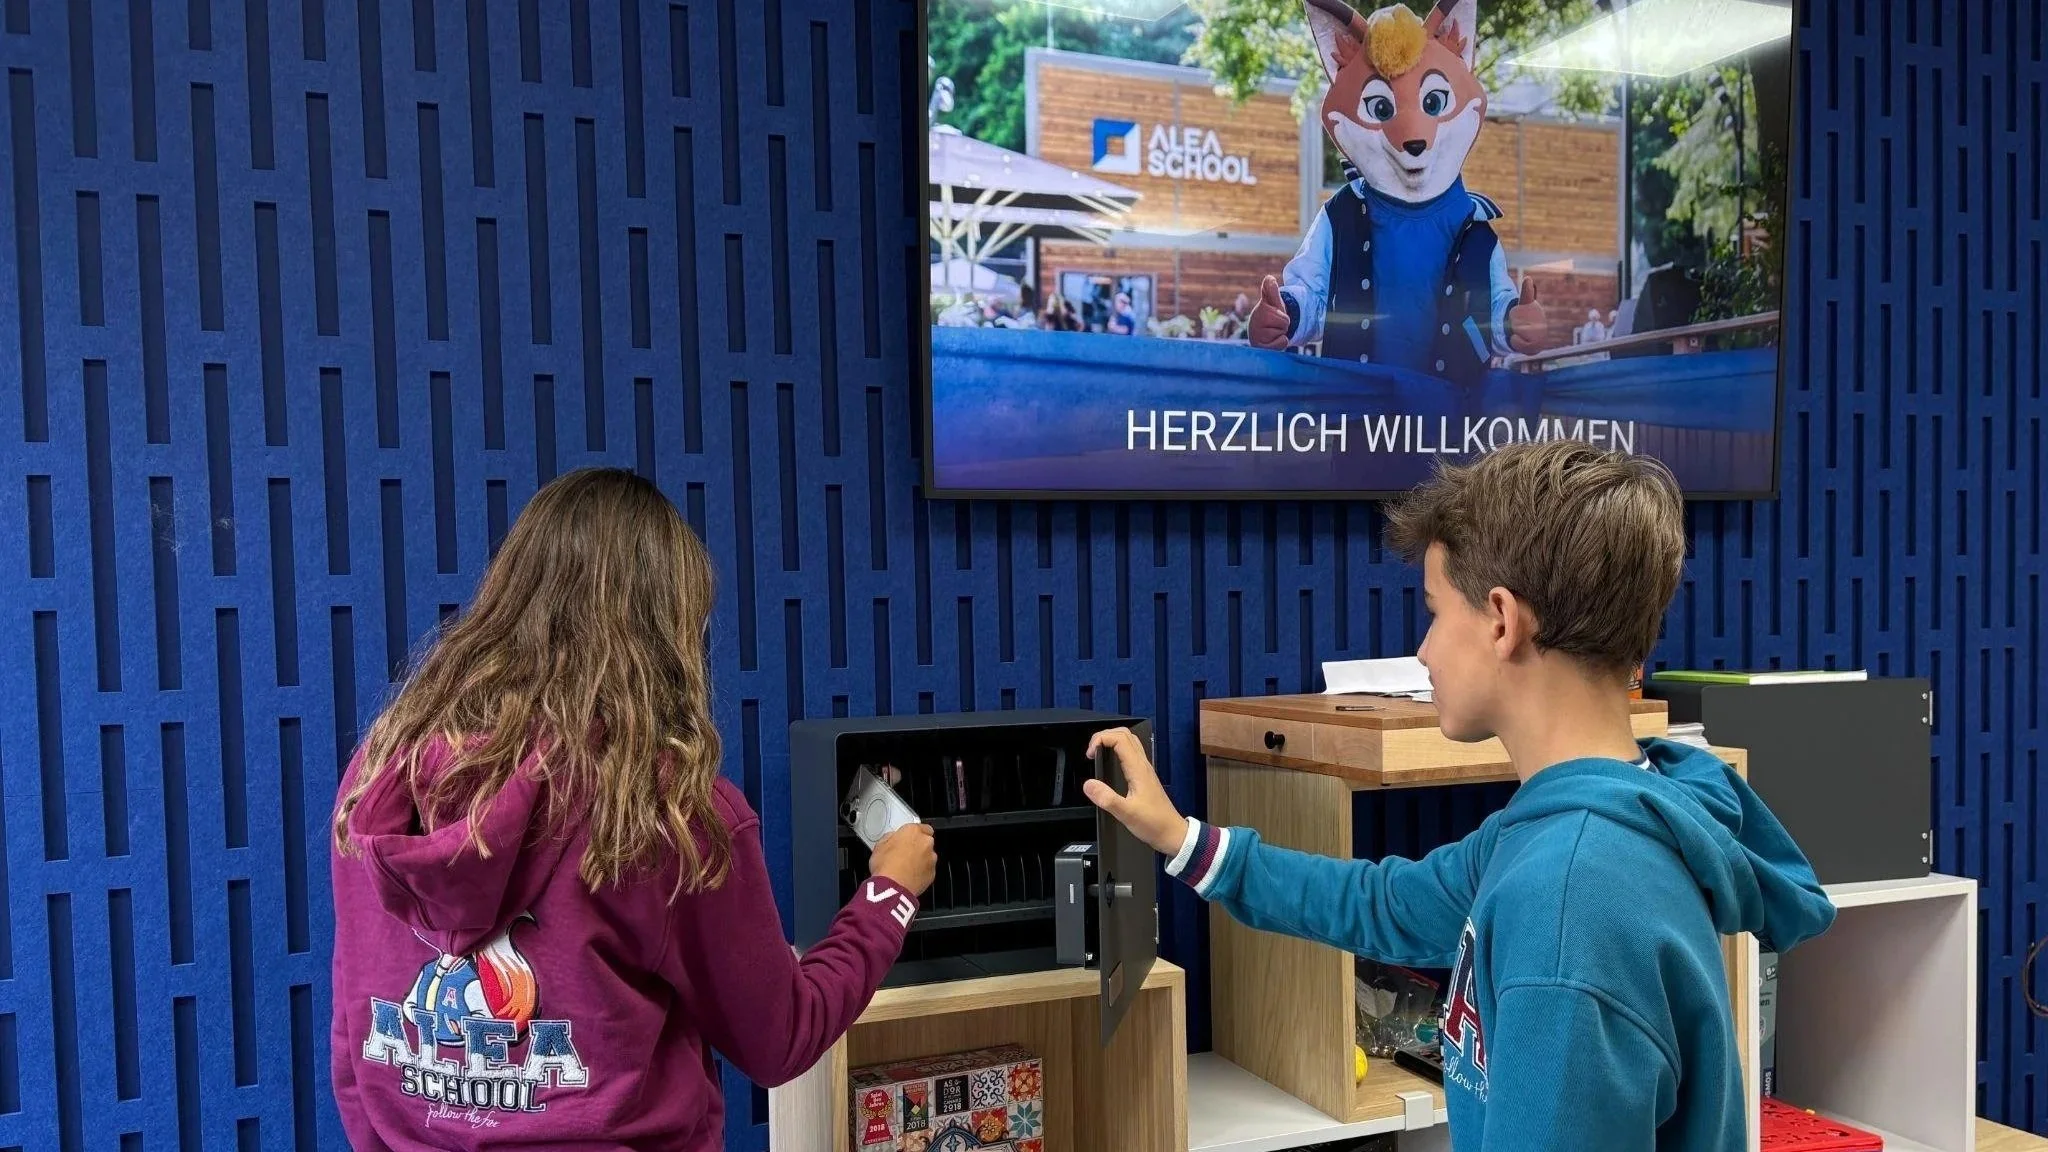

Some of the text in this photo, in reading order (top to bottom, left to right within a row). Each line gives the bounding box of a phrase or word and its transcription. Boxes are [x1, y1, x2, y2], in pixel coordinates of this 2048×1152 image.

[1148, 124, 1223, 157] ALEA
[1148, 149, 1257, 185] SCHOOL
[1127, 410, 1634, 456] HERZLICH WILLKOMMEN
[363, 997, 588, 1088] ALEA
[401, 1063, 547, 1113] SCHOOL
[424, 1102, 462, 1128] follow
[464, 1106, 482, 1123] the
[906, 1119, 926, 1130] 2018
[943, 1103, 962, 1113] 2018
